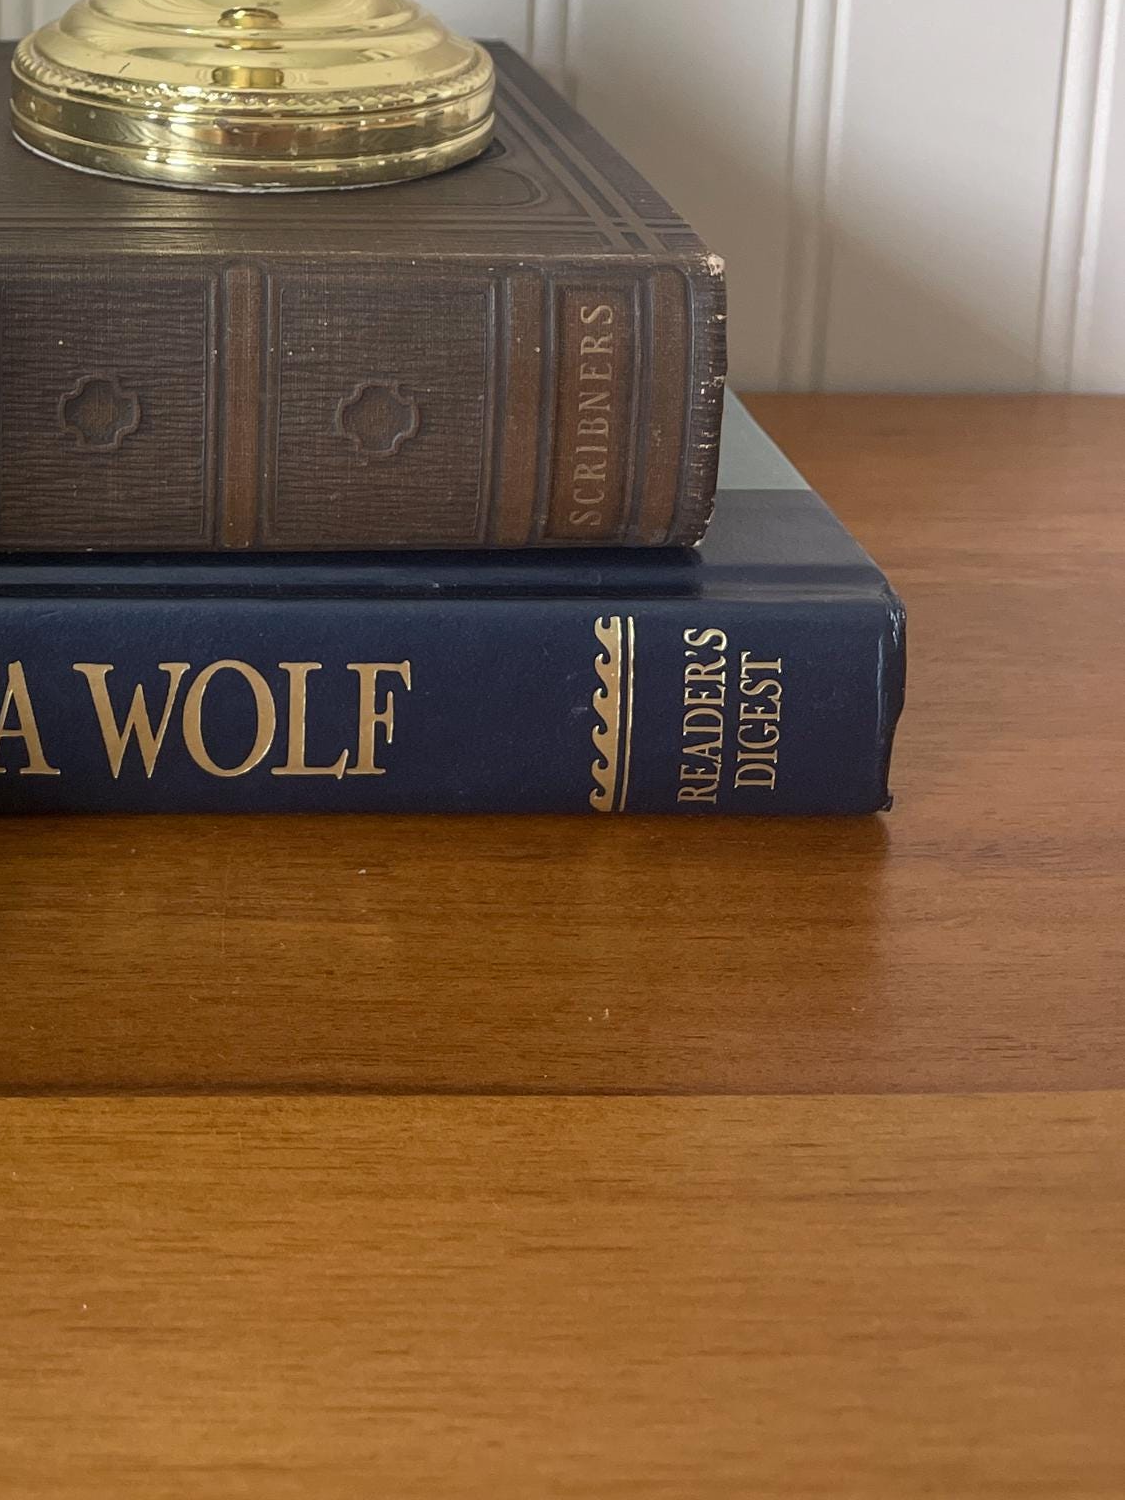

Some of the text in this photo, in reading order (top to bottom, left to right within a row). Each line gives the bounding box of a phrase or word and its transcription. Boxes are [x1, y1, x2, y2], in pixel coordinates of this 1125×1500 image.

[569, 303, 615, 527] SCRIBNERS
[73, 658, 413, 781] WOLF
[676, 627, 728, 805] READER'S
[734, 650, 784, 791] DIGEST
